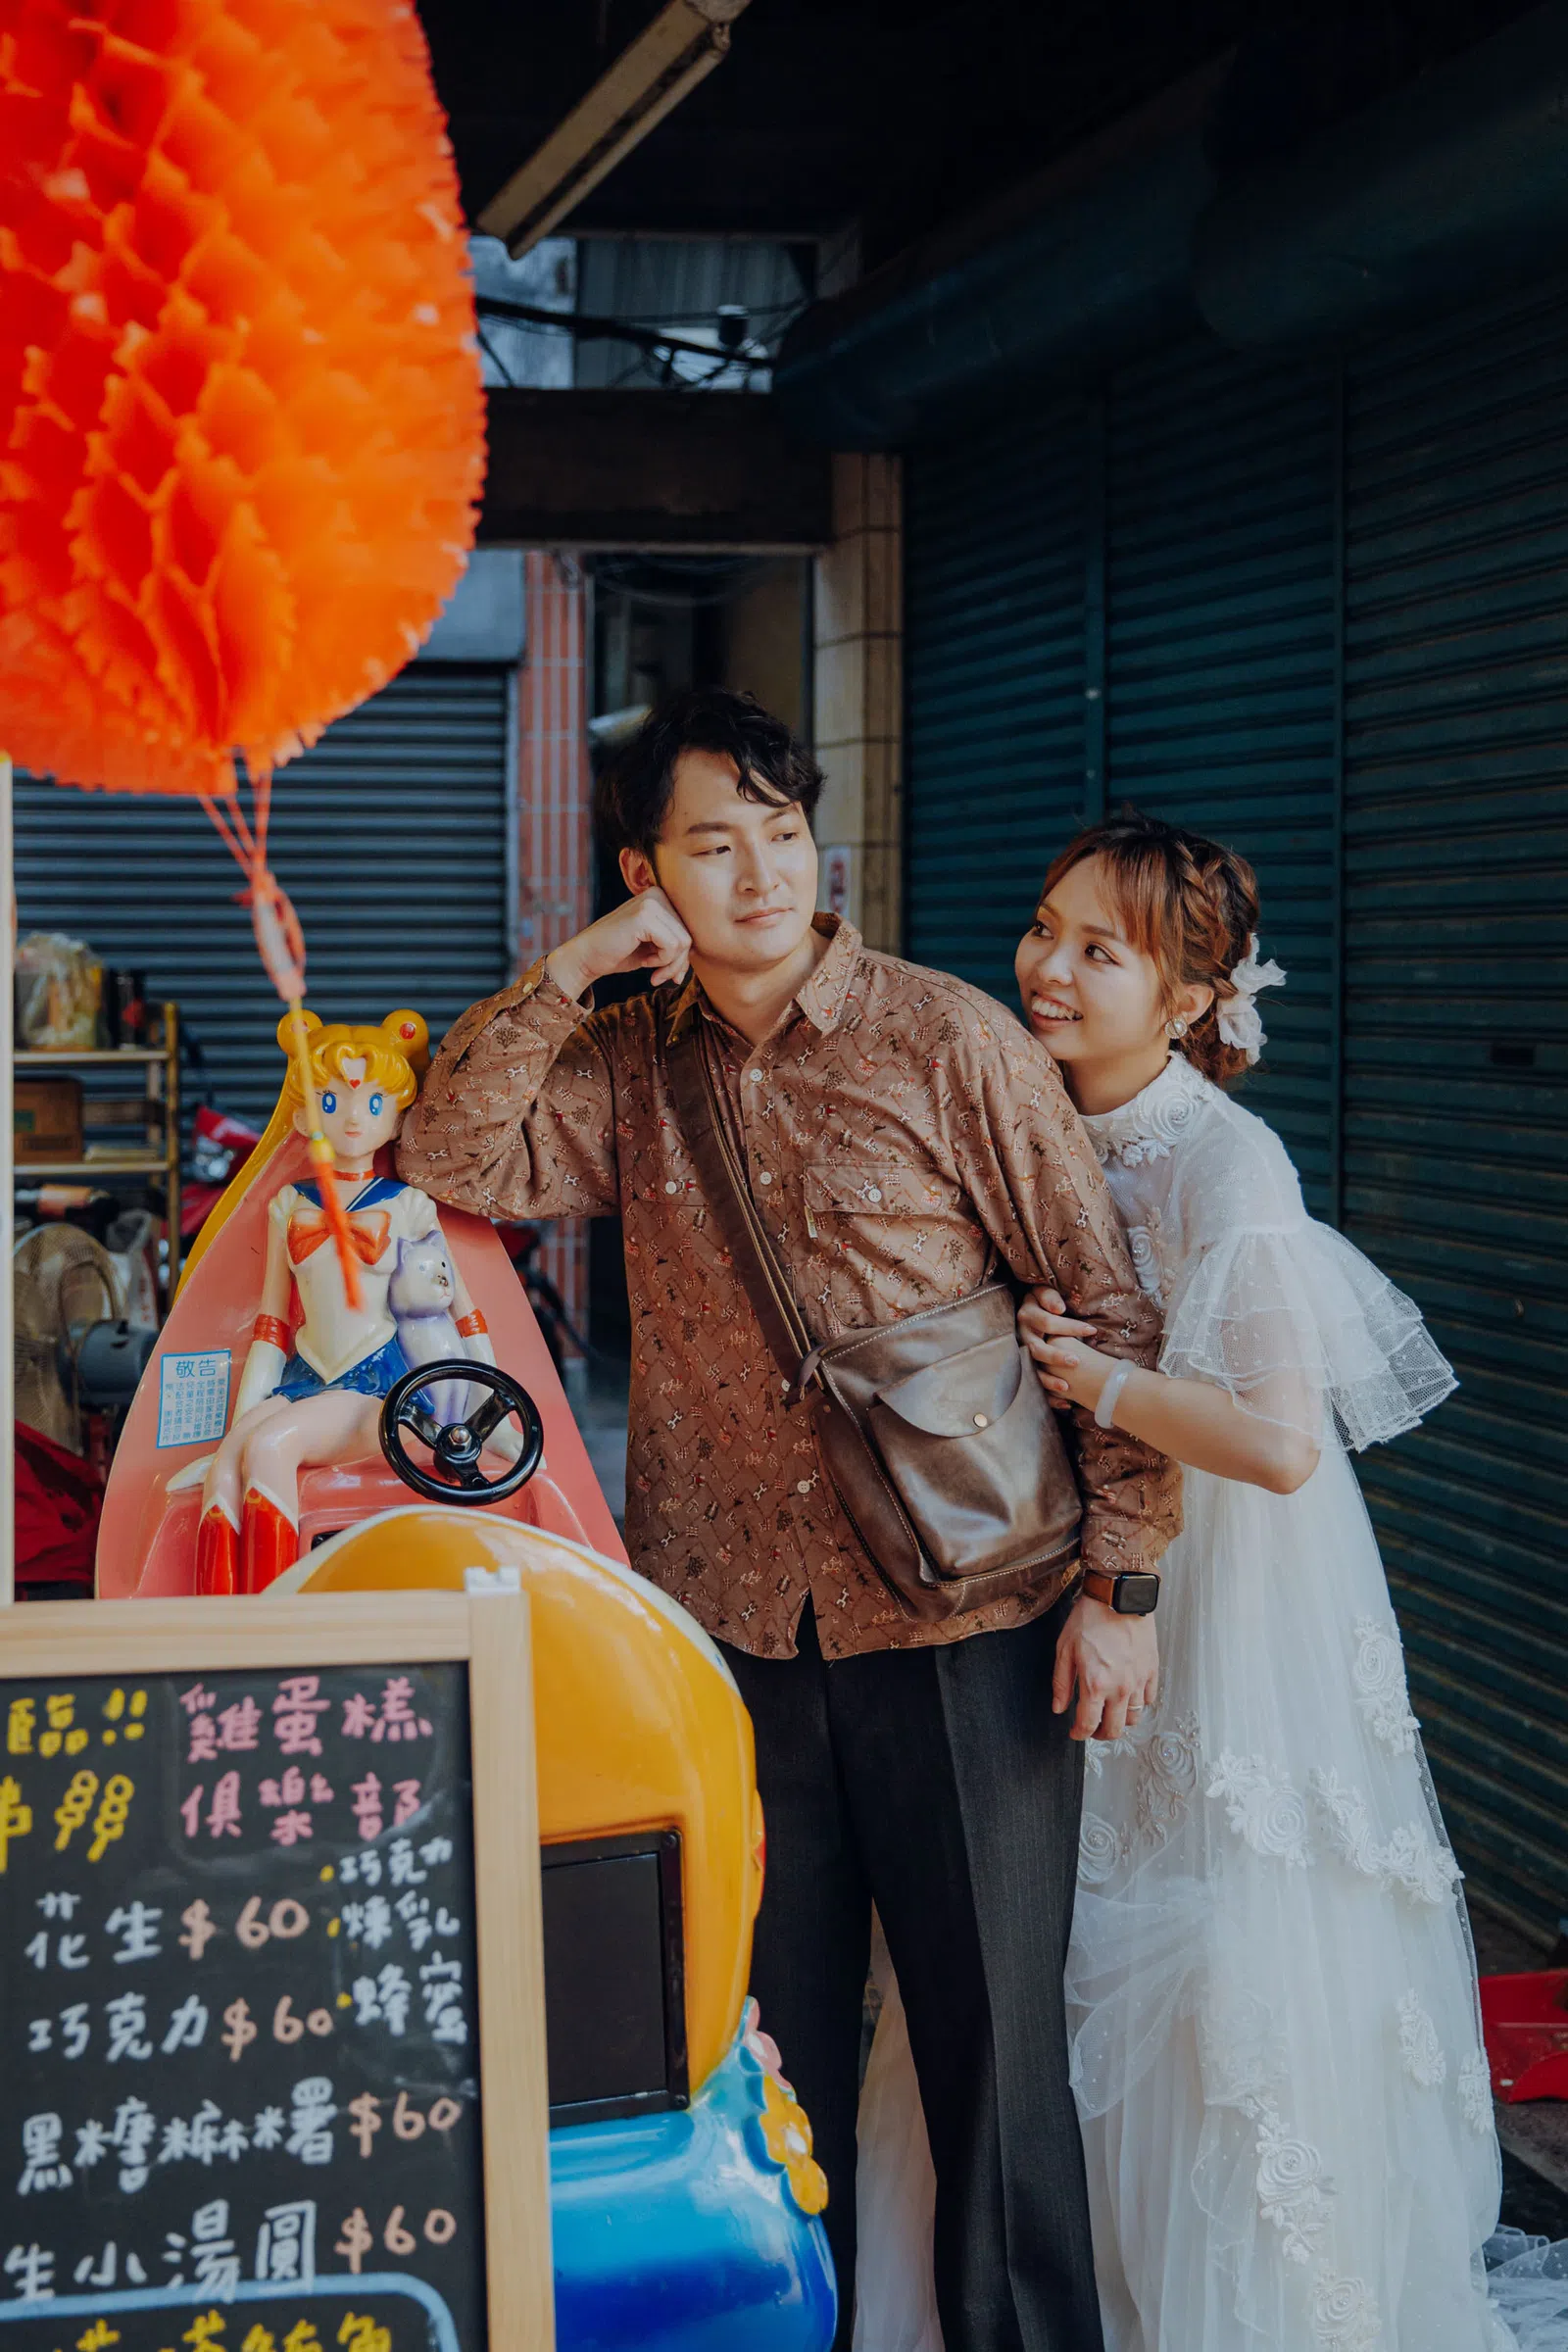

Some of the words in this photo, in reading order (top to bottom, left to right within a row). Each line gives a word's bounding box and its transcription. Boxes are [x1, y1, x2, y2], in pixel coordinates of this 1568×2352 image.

[175, 1359, 217, 1379] 敬告
[179, 1675, 433, 1763] 雞蛋糕
[179, 1766, 423, 1846] 俱樂部
[339, 1836, 453, 1886] 巧克力
[24, 1890, 165, 1969] 花生
[178, 1895, 310, 1960] $60
[27, 1990, 210, 2062] 巧克力
[220, 1994, 334, 2062] $60
[353, 1950, 467, 2045] 蜂蜜
[348, 2090, 463, 2158] $60
[334, 2205, 457, 2275] $60
